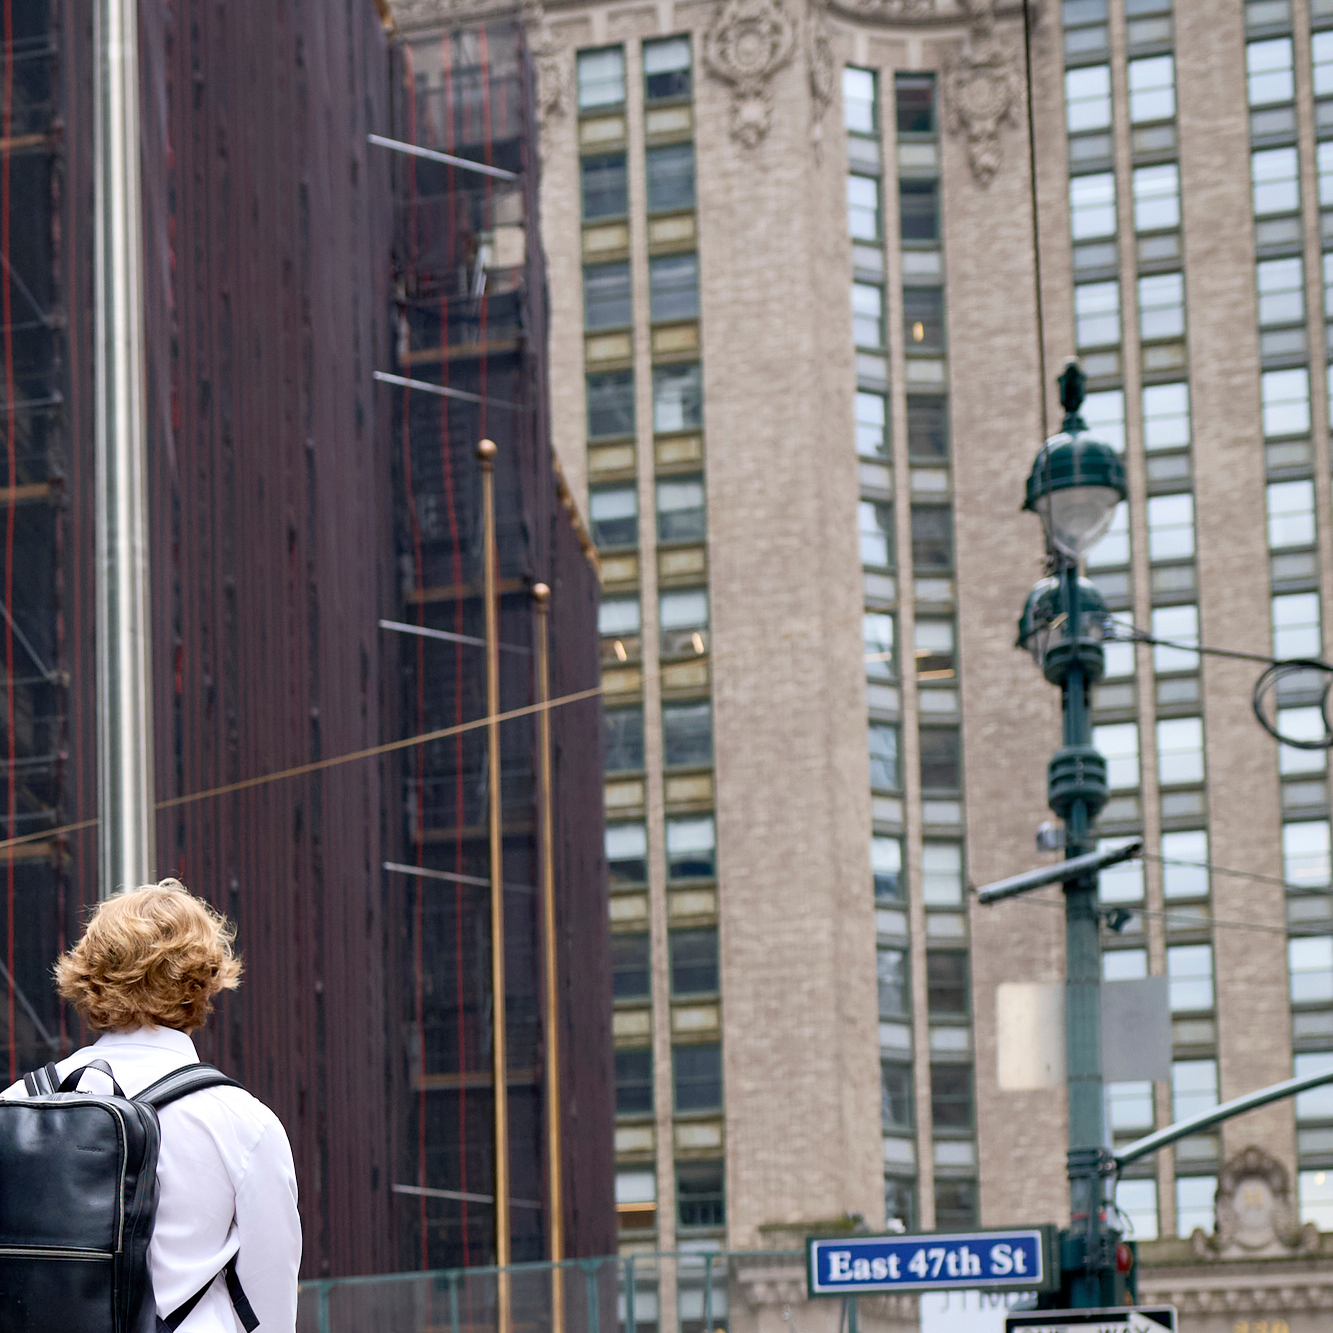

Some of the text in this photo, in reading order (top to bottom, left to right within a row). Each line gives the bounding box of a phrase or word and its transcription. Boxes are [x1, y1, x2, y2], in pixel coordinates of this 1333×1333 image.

[827, 1243, 1027, 1282] East 47th St
